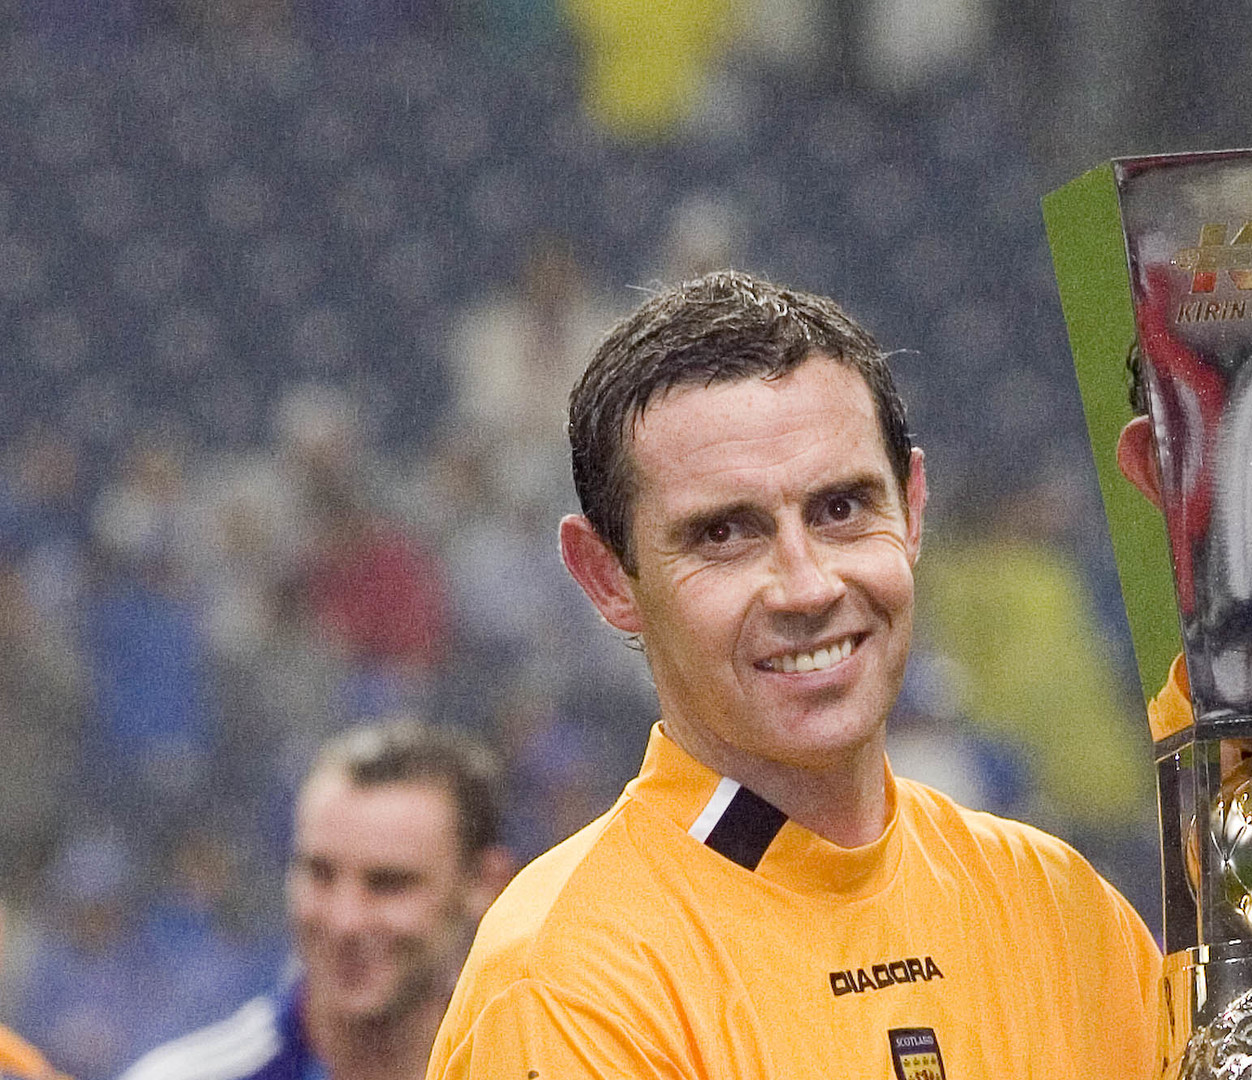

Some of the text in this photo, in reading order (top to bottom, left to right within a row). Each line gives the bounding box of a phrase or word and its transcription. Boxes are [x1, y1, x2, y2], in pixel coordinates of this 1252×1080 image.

[1175, 300, 1246, 323] KIRIN
[829, 956, 944, 996] DIADORA
[895, 1035, 934, 1047] SCOTLAND
